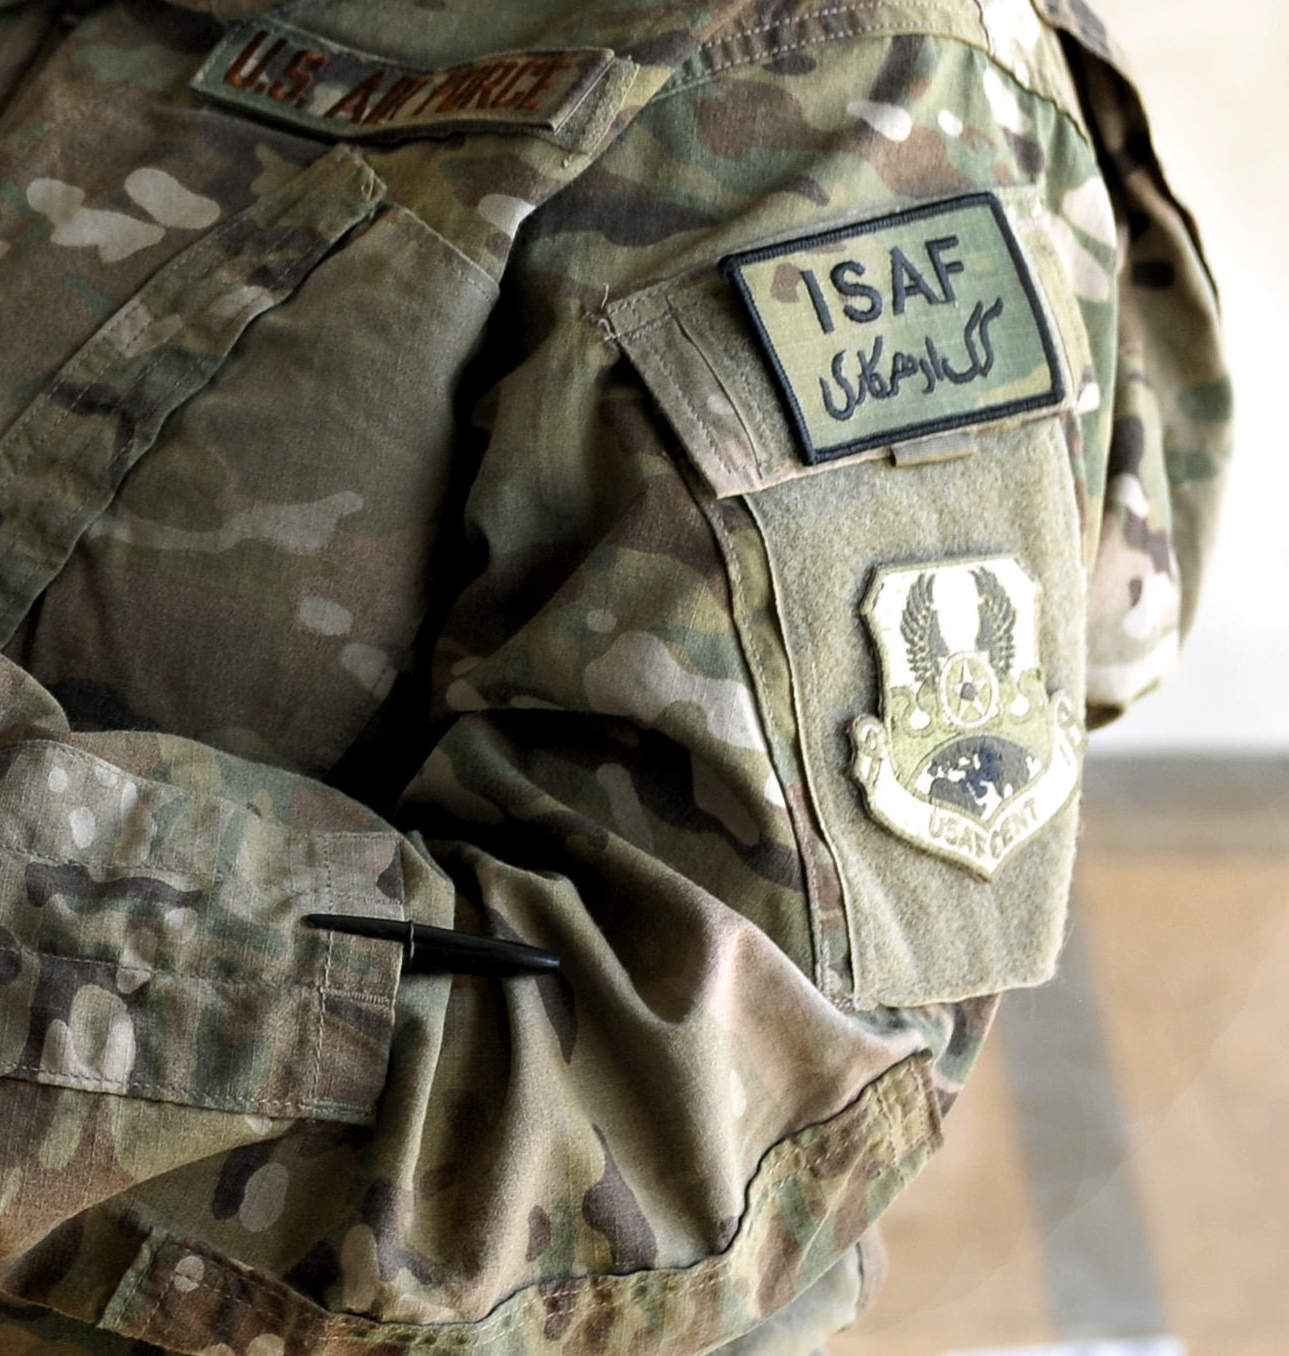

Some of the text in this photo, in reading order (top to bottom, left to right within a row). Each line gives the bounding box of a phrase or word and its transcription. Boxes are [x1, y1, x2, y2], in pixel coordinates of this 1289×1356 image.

[224, 30, 575, 124] U.S. AIR FORCE
[800, 235, 965, 334] ISAF
